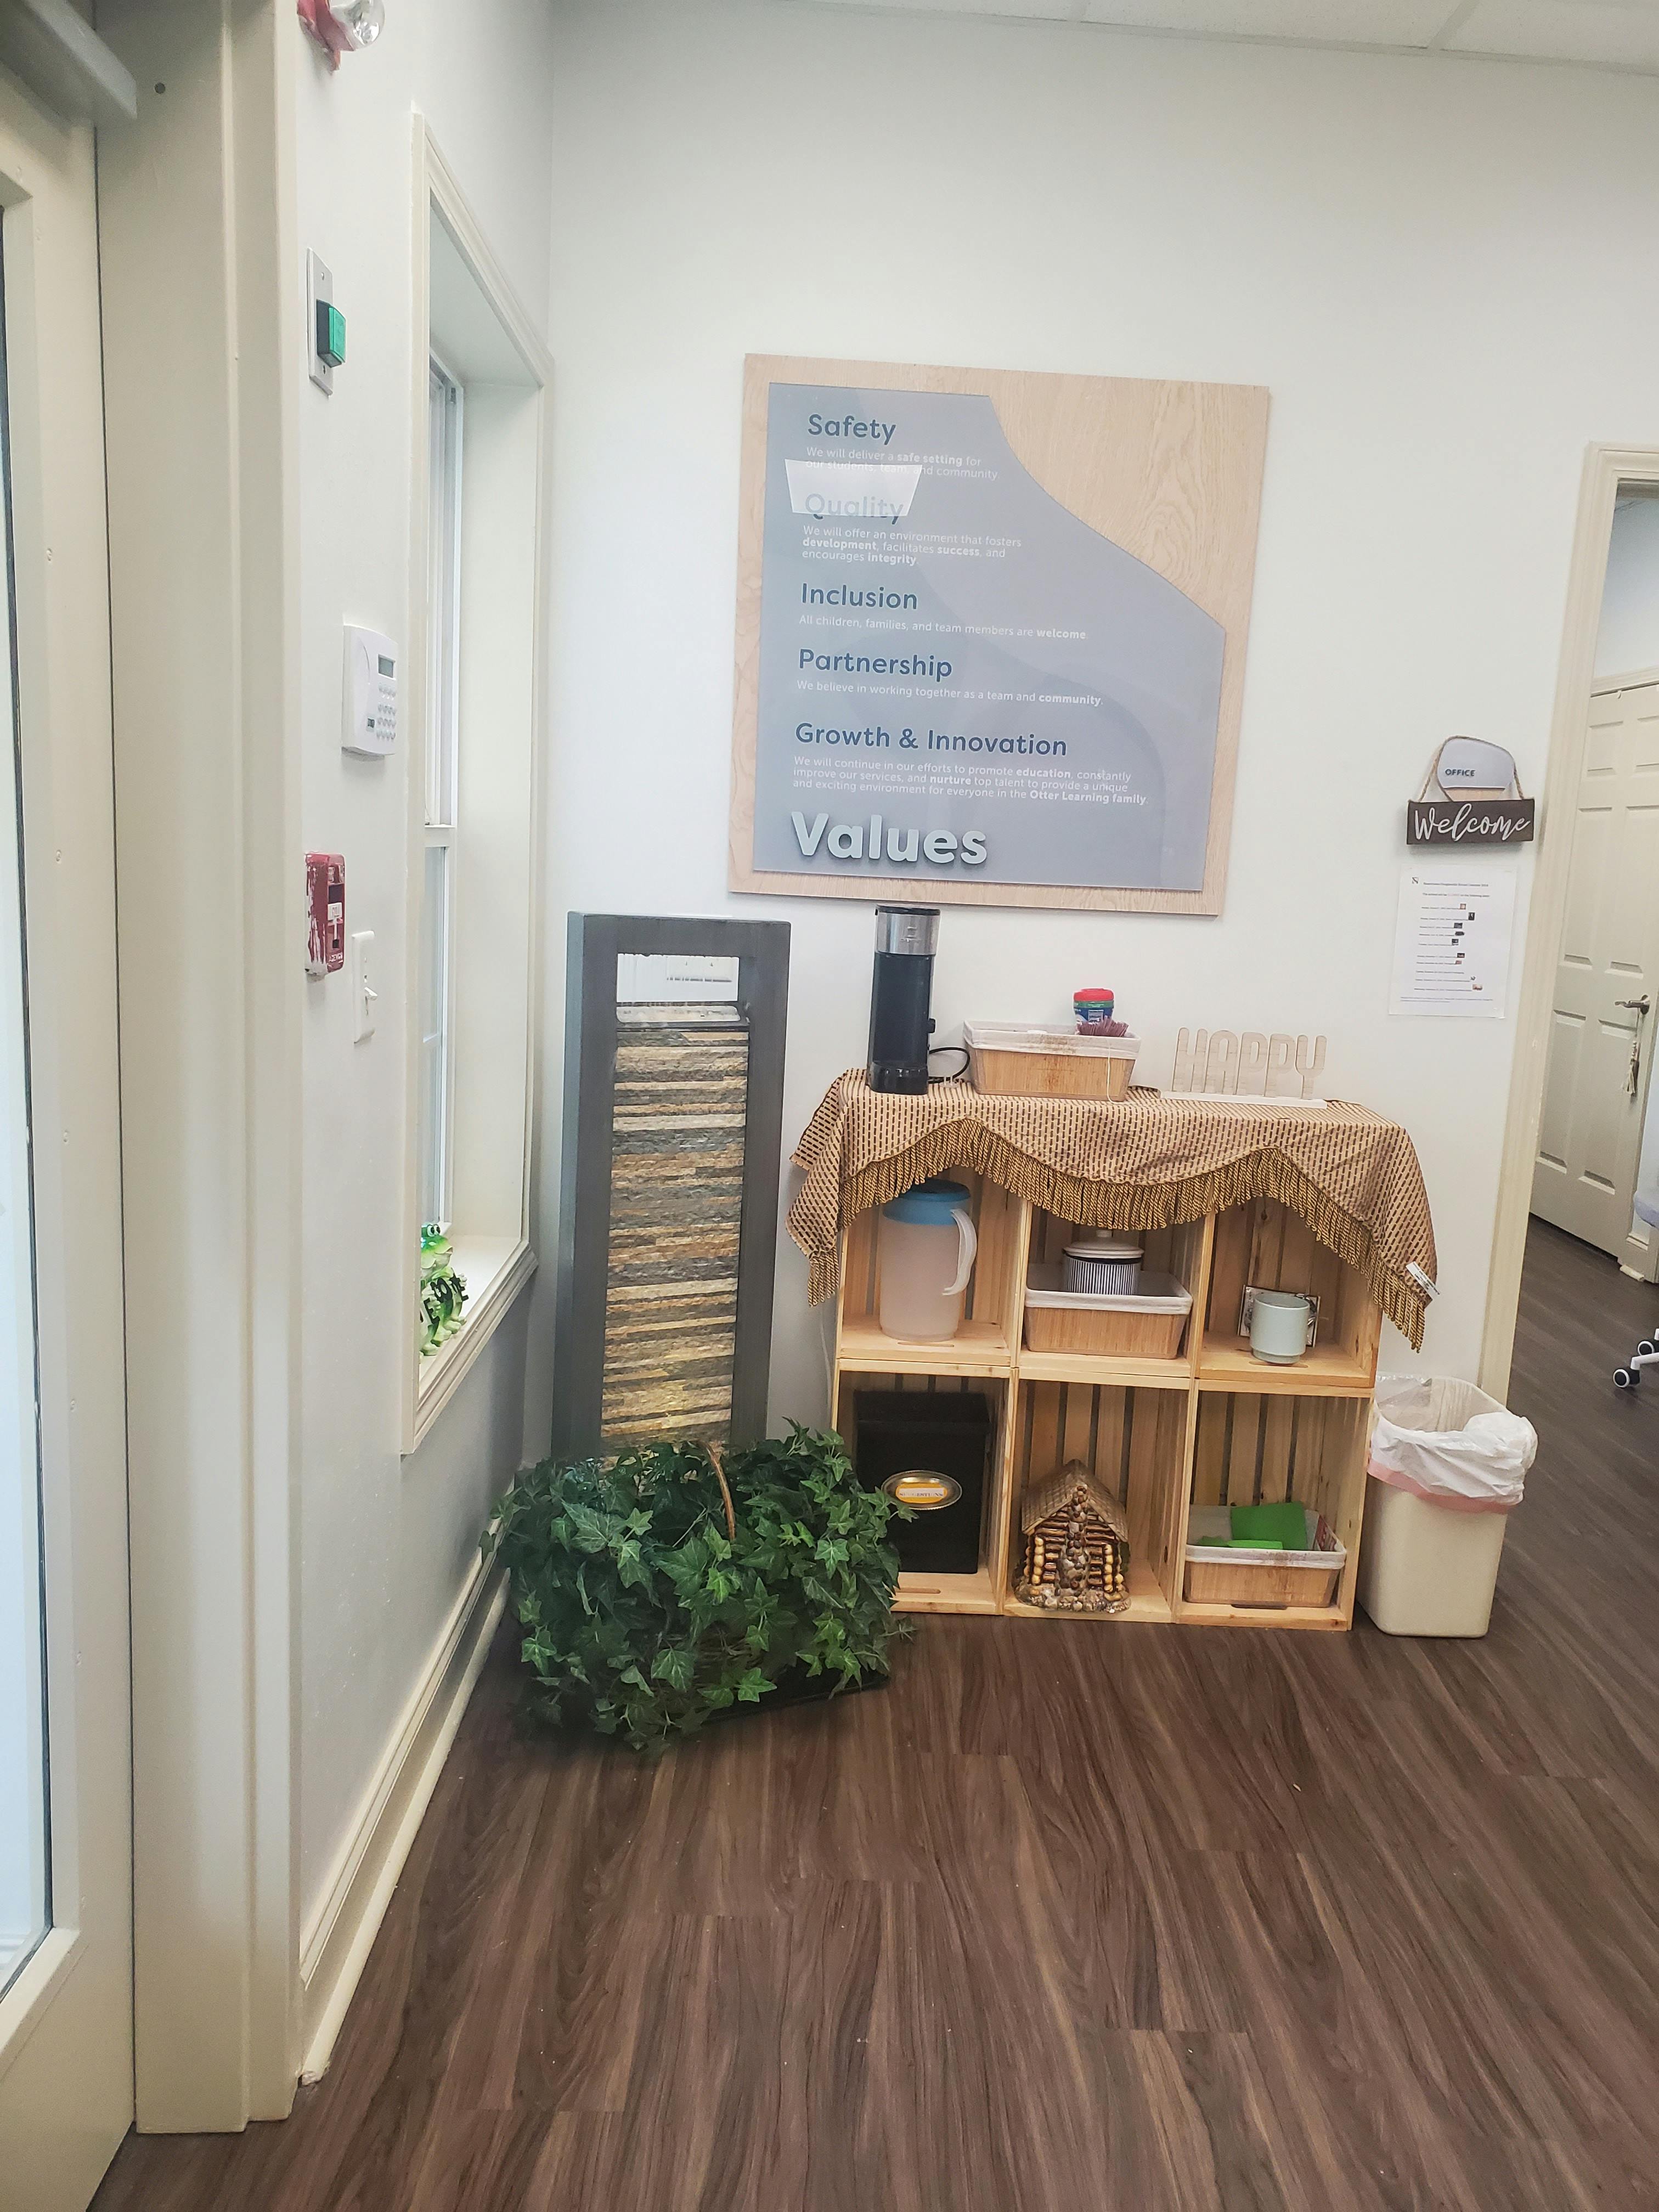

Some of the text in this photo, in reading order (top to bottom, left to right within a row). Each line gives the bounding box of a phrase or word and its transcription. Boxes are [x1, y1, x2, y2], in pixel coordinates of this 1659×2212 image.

[808, 414, 896, 445] Safety
[806, 447, 823, 457] We
[827, 448, 845, 458] will
[849, 449, 885, 460] deliver
[897, 452, 919, 462] safe
[923, 454, 963, 467] setting
[966, 456, 981, 466] for
[913, 465, 933, 475] and
[805, 493, 904, 524] Quality
[803, 526, 1022, 548] We will offer an environment that fosters
[803, 538, 1006, 558] development, facilitates success, and
[802, 551, 864, 562] encourages
[802, 583, 918, 610] Inclusion
[799, 614, 813, 625] All
[816, 616, 862, 628] children,
[866, 619, 909, 631] families,
[912, 620, 932, 631] and
[935, 623, 961, 633] team
[965, 625, 1014, 635] members
[1017, 628, 1034, 637] are
[798, 648, 952, 682] Partnership
[797, 680, 1103, 707] We believe in working together as a team and community.
[795, 722, 1067, 757] Growth & Innovation
[793, 768, 836, 779] improve
[839, 771, 857, 780] our
[860, 770, 904, 782] services,
[907, 773, 927, 783] and
[930, 774, 972, 785] nurture
[974, 777, 991, 787] top
[995, 778, 1024, 788] talent
[1028, 780, 1038, 788] to
[1041, 780, 1080, 791] provide
[1092, 783, 1127, 793] unique
[794, 756, 1131, 782] We will continue in our efforts to promote education, constantly
[1445, 769, 1476, 777] OFFICE
[793, 779, 812, 788] and
[815, 781, 856, 793] exciting
[859, 783, 926, 794] environment
[929, 786, 944, 795] for
[947, 789, 994, 799] everyone
[997, 789, 1006, 797] in
[1010, 789, 1027, 799] the
[1030, 790, 1059, 800] Otter
[1062, 791, 1109, 804] Learning
[1414, 803, 1531, 842] Welcome
[791, 811, 988, 865] Values
[1172, 1027, 1327, 1101] HAPPY
